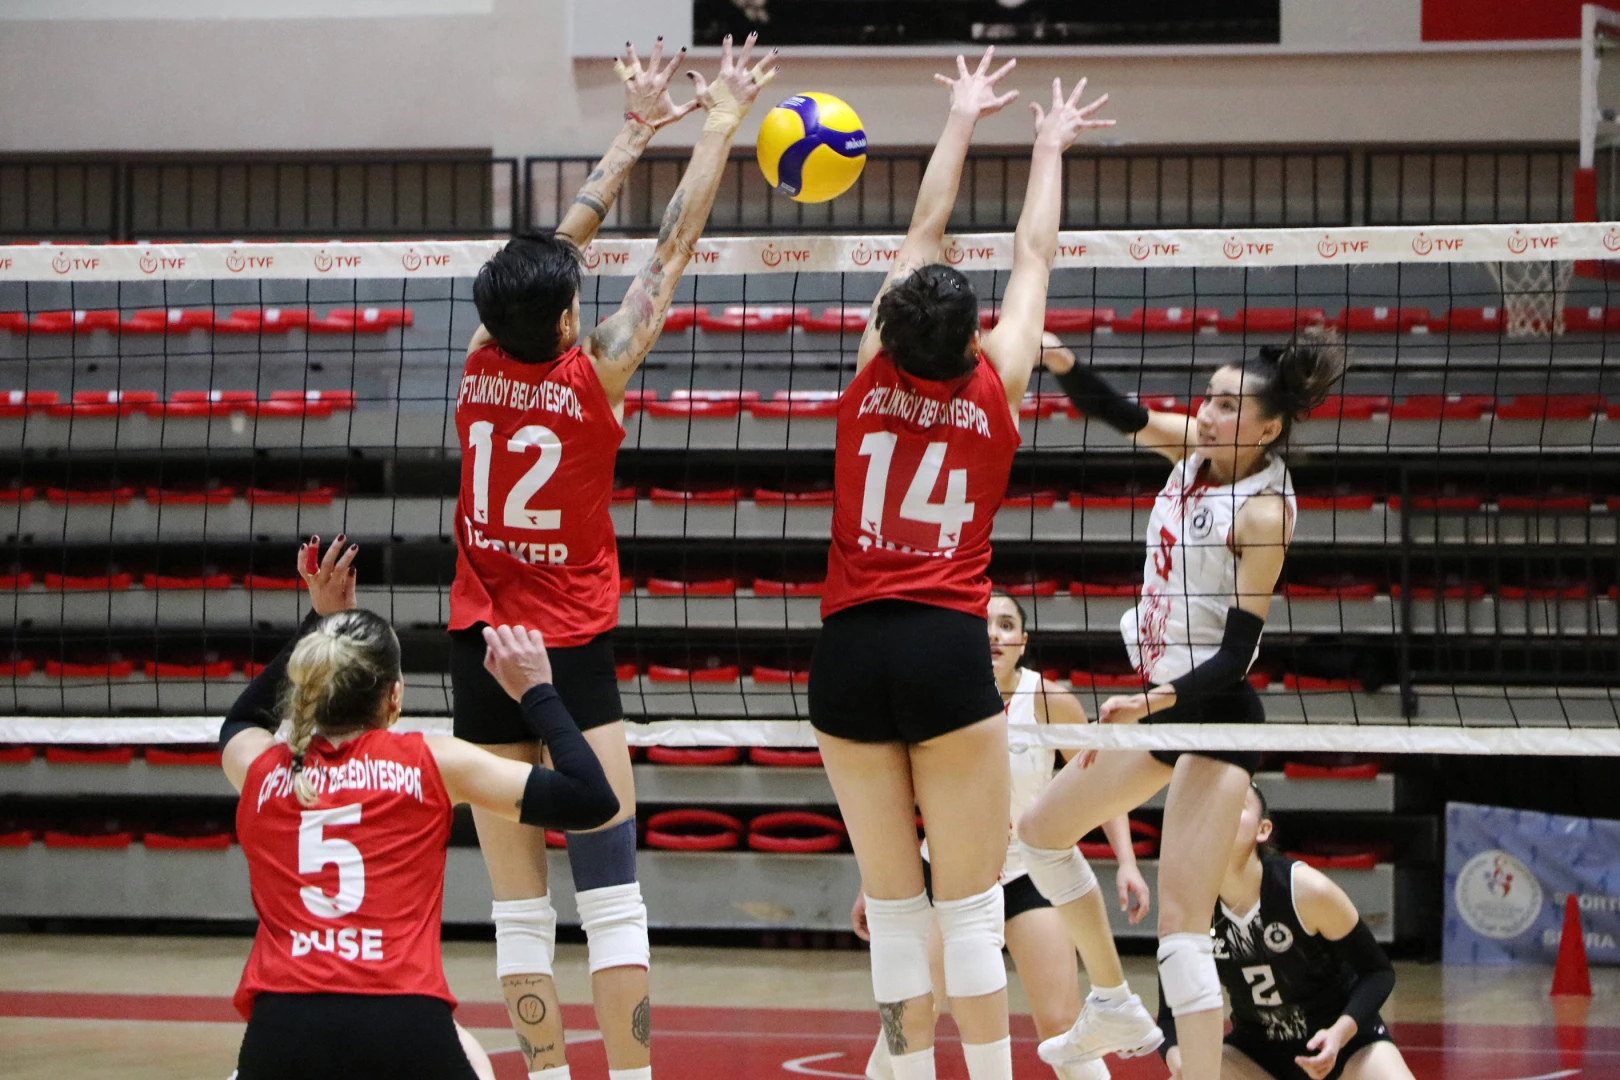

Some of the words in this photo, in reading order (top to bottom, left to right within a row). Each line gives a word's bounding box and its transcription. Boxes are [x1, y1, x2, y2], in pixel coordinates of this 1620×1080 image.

[1246, 243, 1274, 255] TVF
[1340, 241, 1369, 252] TVF
[1435, 239, 1463, 251] TVF
[1530, 237, 1559, 249] TVF
[967, 248, 994, 260] TVF
[1061, 245, 1087, 257] TVF
[1153, 244, 1180, 256] TVF
[249, 256, 274, 268] TVF
[335, 256, 362, 267] TVF
[424, 255, 450, 266] TVF
[603, 253, 629, 264] TVF
[693, 252, 719, 263] TVF
[784, 251, 810, 262] TVF
[75, 259, 99, 270] TVF
[160, 258, 186, 269] TVF
[456, 368, 511, 413] İFTLİKKÖY
[469, 420, 562, 530] 12
[858, 431, 975, 548] 14
[298, 803, 365, 918] 5
[1241, 964, 1283, 1006] 2
